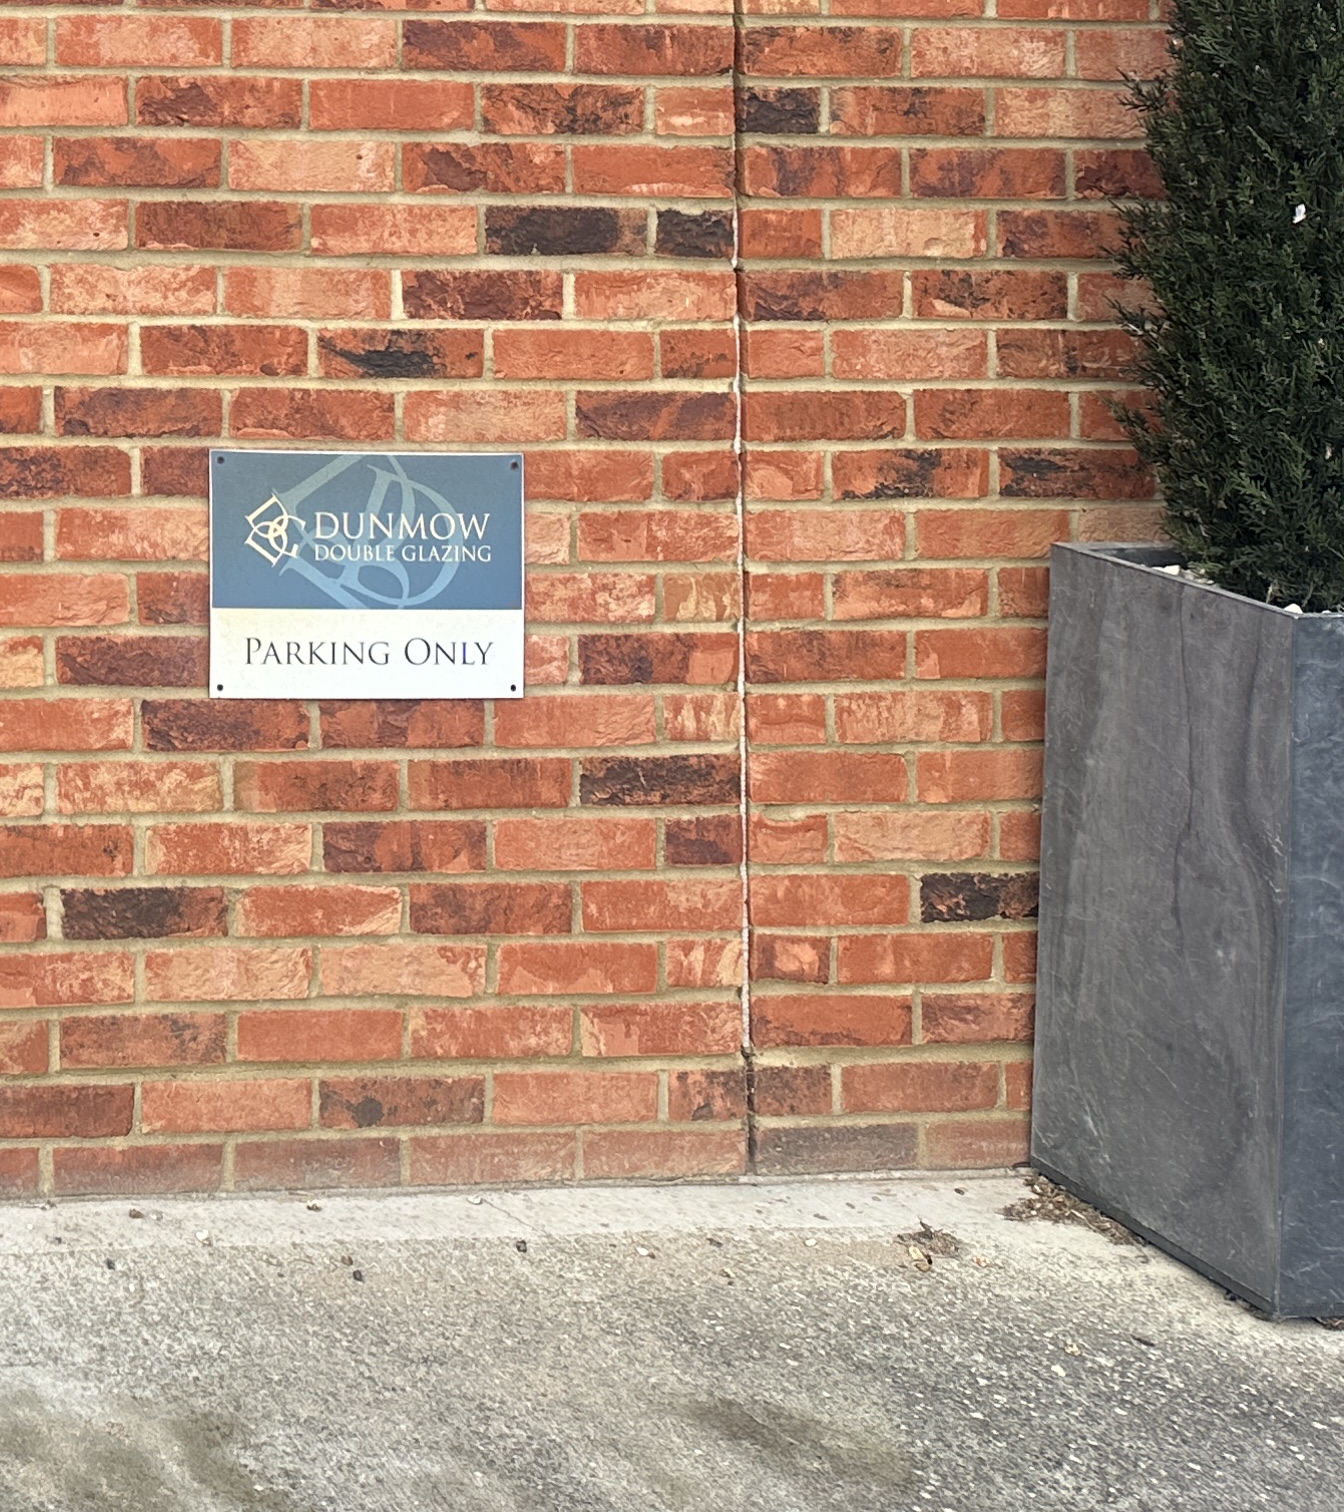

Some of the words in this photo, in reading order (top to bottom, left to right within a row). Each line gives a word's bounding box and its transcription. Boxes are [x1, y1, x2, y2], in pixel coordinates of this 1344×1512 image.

[314, 511, 491, 541] DUNMOW
[314, 544, 395, 563] DOUBLE
[401, 544, 492, 563] GLAZING
